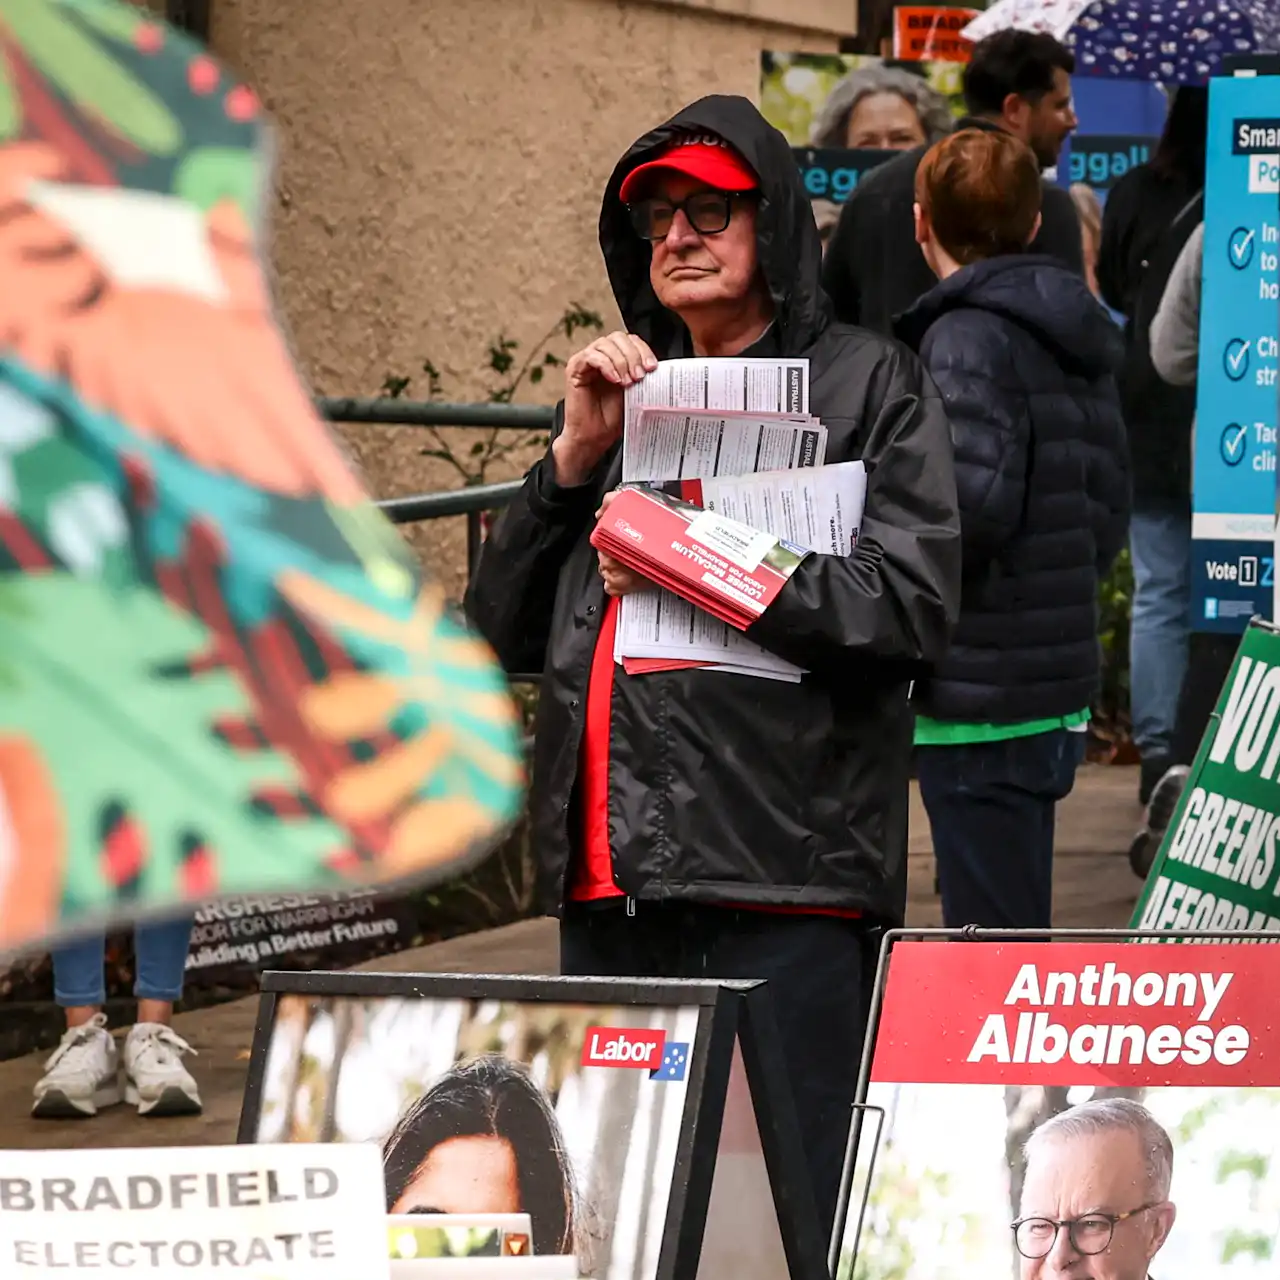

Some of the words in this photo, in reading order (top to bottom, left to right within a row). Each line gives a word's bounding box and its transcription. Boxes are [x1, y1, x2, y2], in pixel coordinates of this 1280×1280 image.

[670, 540, 726, 578] McCALLUM
[691, 543, 729, 569] BRADFIELD
[728, 566, 744, 578] FOR
[1206, 560, 1237, 580] Vote
[726, 574, 763, 600] LOUISE
[743, 575, 767, 592] LABOR
[231, 915, 267, 938] FOR
[267, 900, 375, 930] WARRINGAH
[260, 940, 272, 955] a
[271, 929, 333, 952] Better
[334, 917, 399, 943] Future
[1003, 962, 1235, 1022] Anthony
[589, 1034, 656, 1063] Labor
[966, 1012, 1249, 1066] Albanese
[0, 1166, 340, 1214] BRADFIELD
[13, 1230, 336, 1269] ELECTORATE
